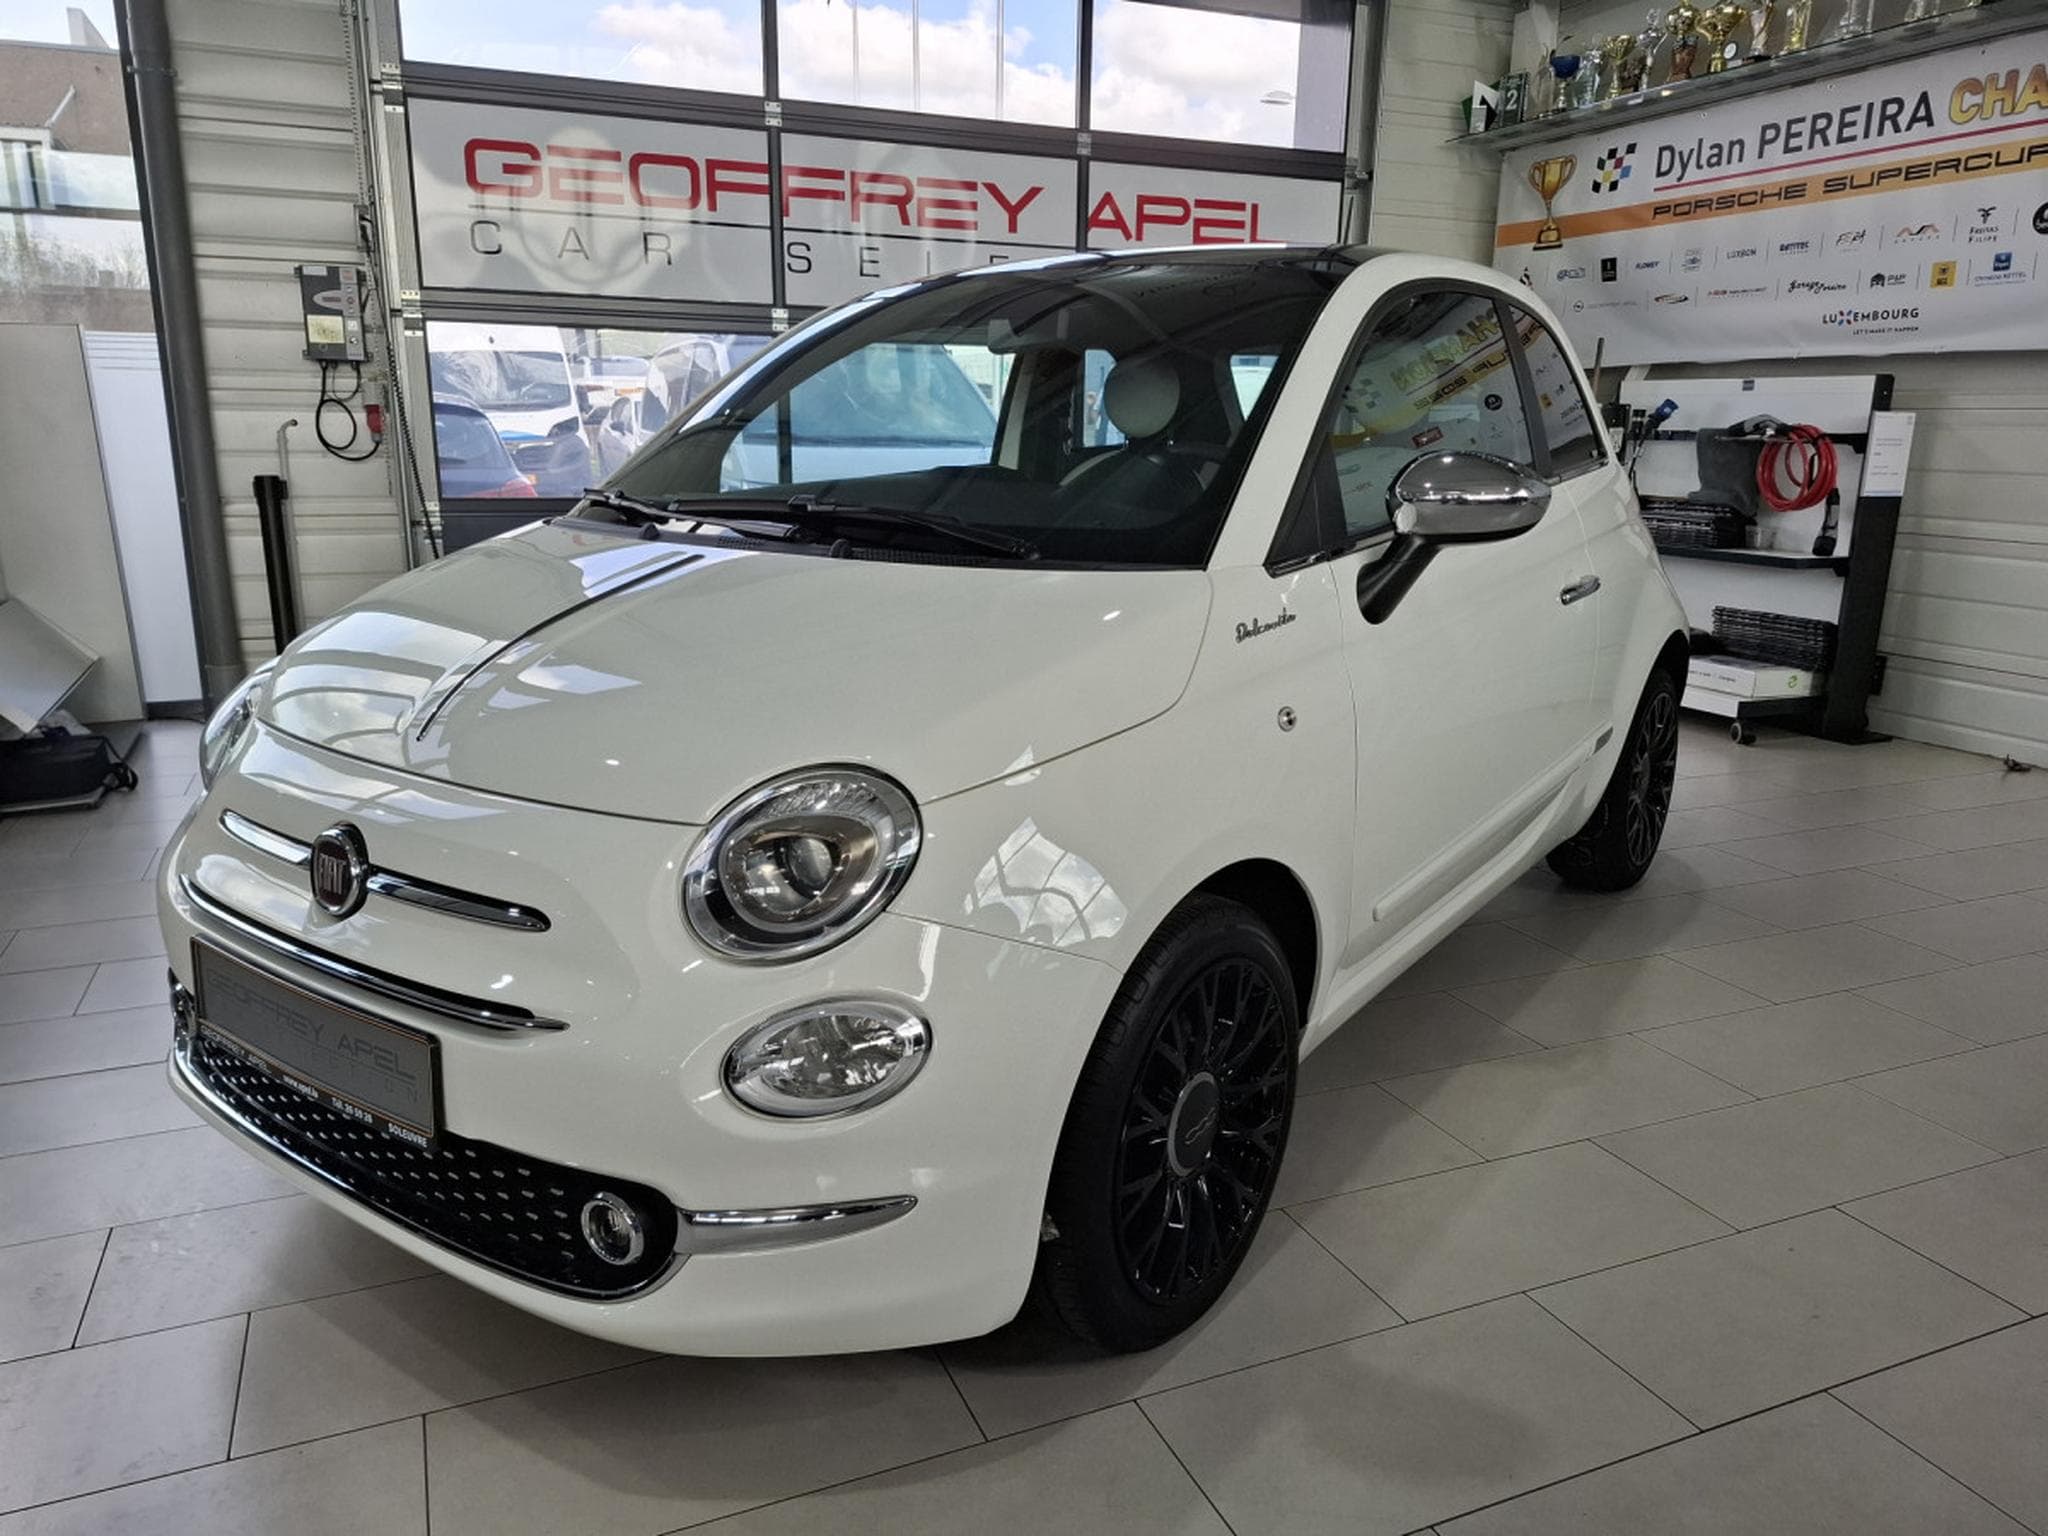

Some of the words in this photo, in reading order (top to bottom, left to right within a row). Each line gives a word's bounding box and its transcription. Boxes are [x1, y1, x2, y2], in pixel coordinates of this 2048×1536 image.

[1655, 138, 1745, 183] Dylan
[1757, 91, 1935, 160] PEREIRA
[464, 138, 1045, 235] GEOFFREY
[1088, 190, 1288, 246] APEL
[1652, 183, 1808, 220] PORSCHE
[470, 219, 673, 266] CAR
[1822, 307, 1920, 326] LUXEMBOURG
[319, 853, 347, 895] FIAT
